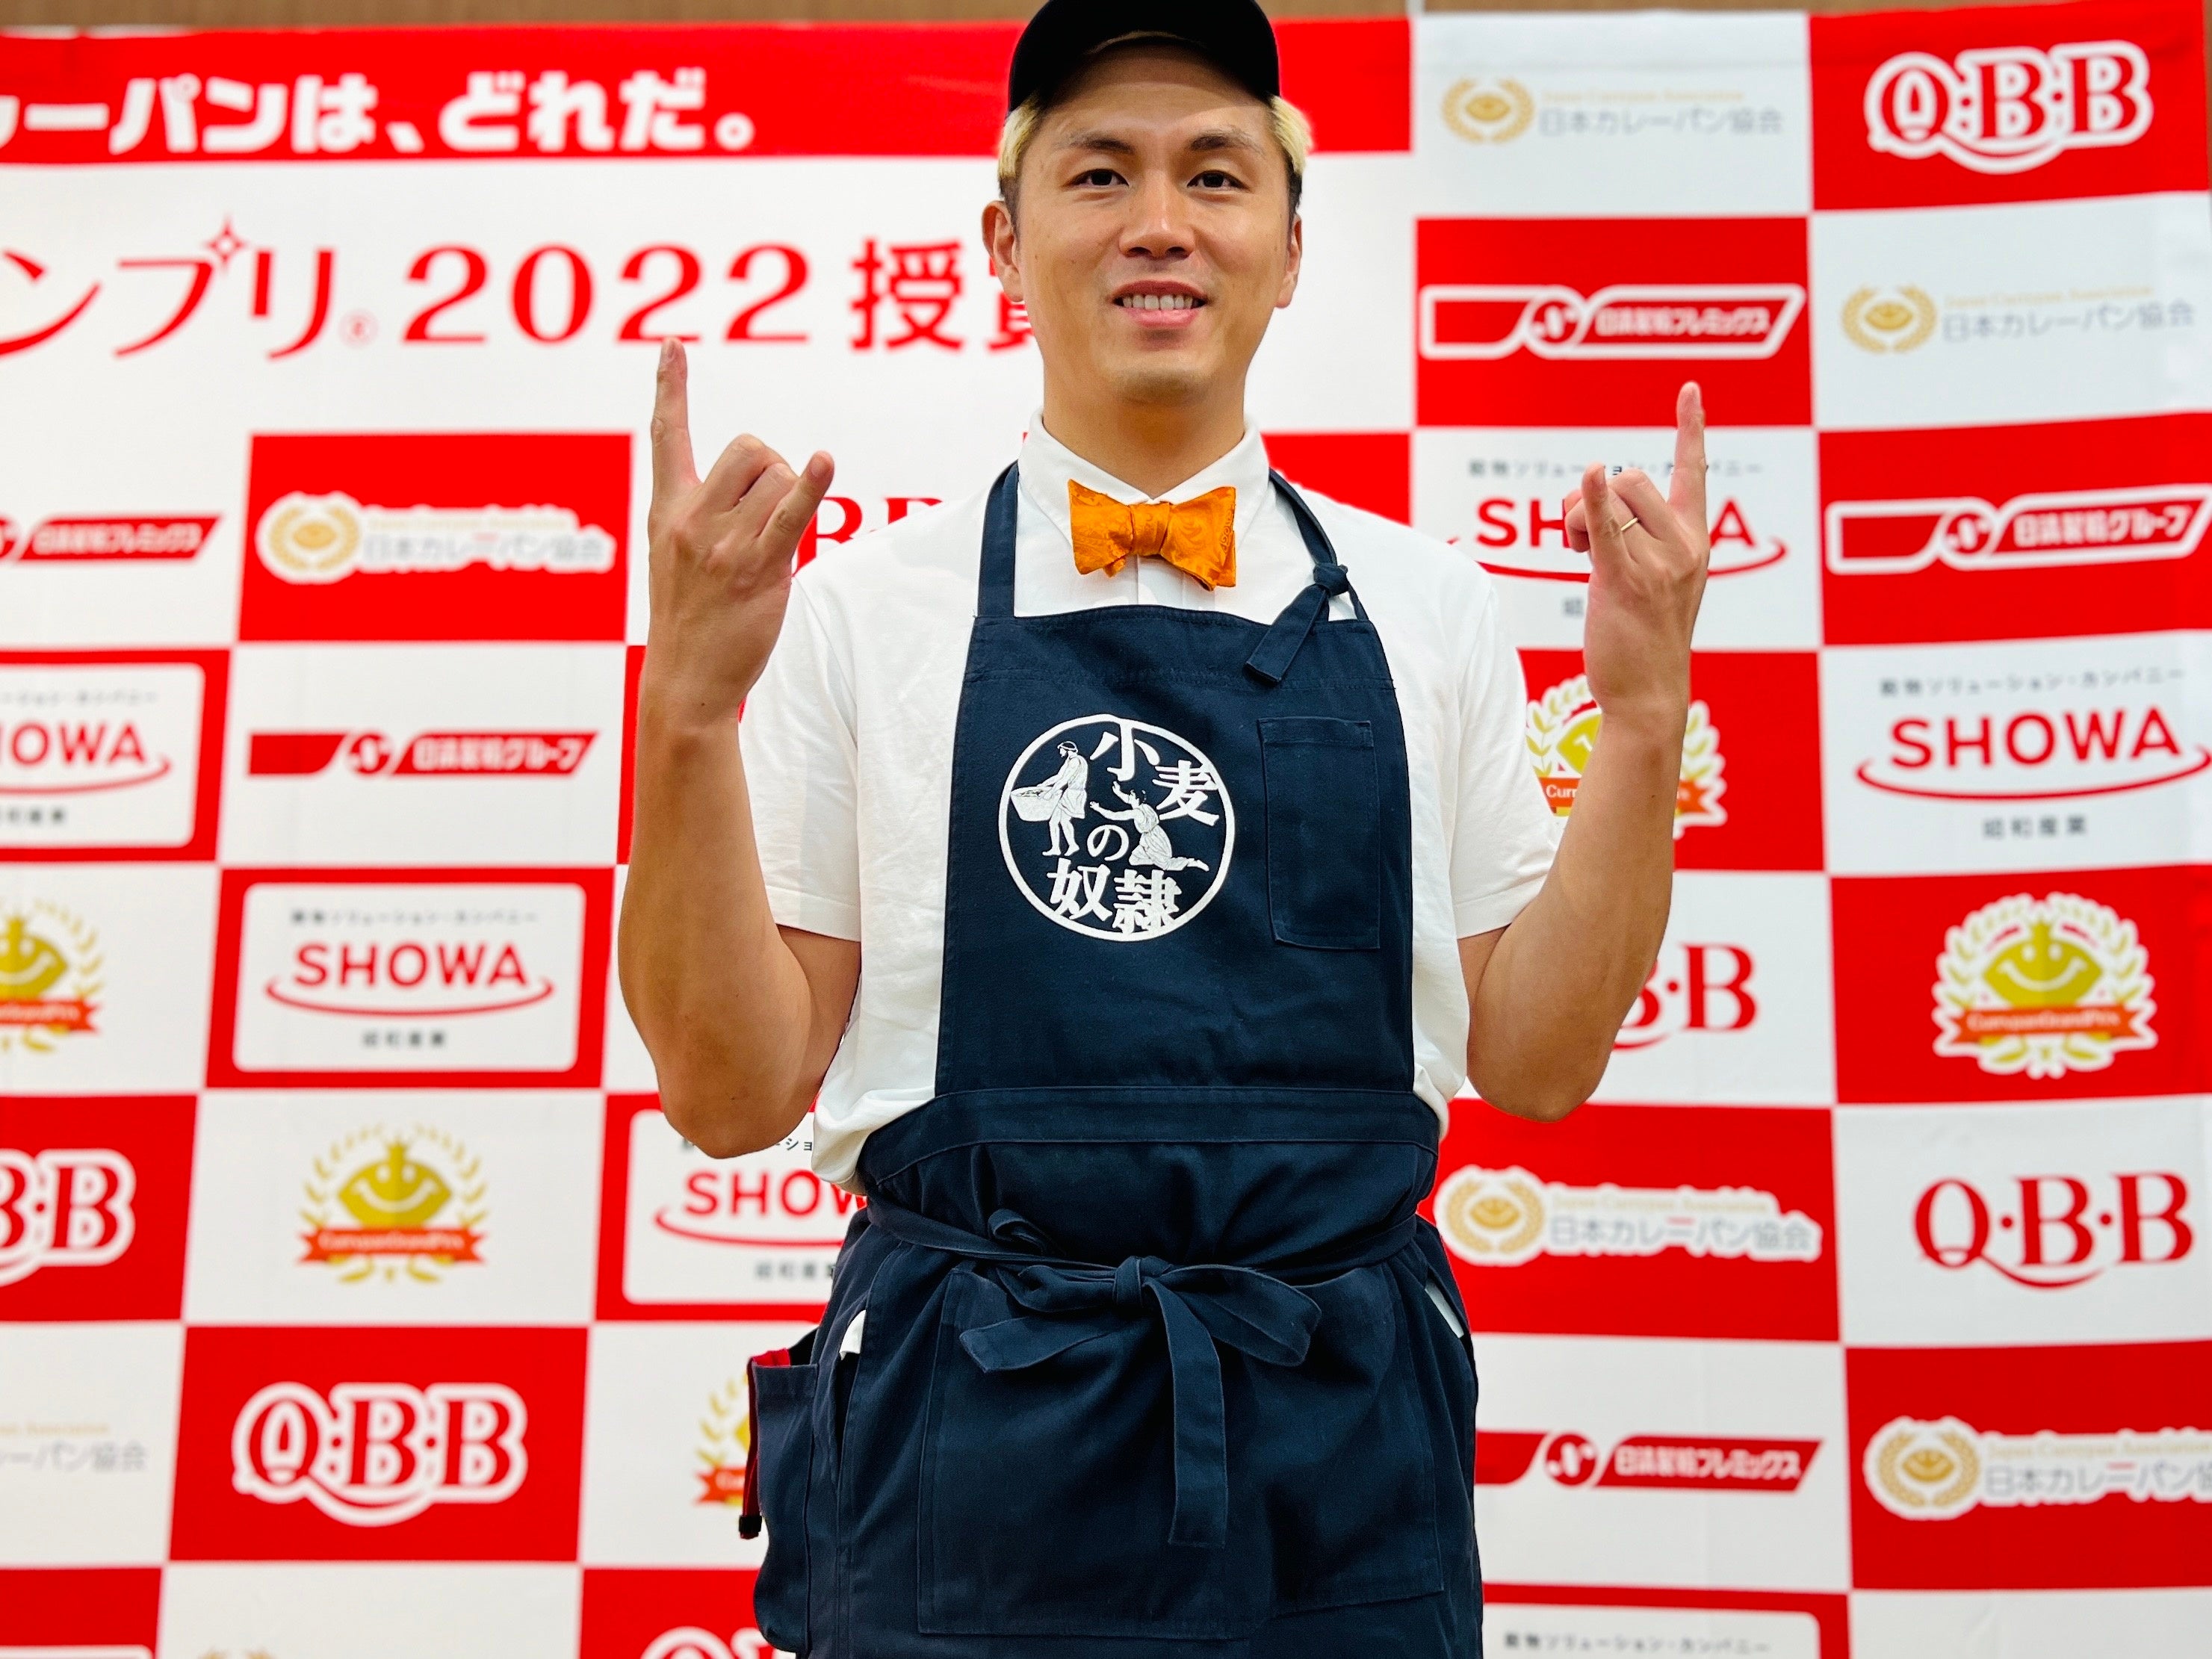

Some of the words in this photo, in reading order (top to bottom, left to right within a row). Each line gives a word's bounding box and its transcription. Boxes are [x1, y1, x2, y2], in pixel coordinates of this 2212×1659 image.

[402, 244, 809, 344] 2022
[1475, 497, 1756, 549] SHA
[0, 722, 146, 767] OWA
[1891, 706, 2182, 770] SHOWA
[294, 943, 527, 987] SHOWA
